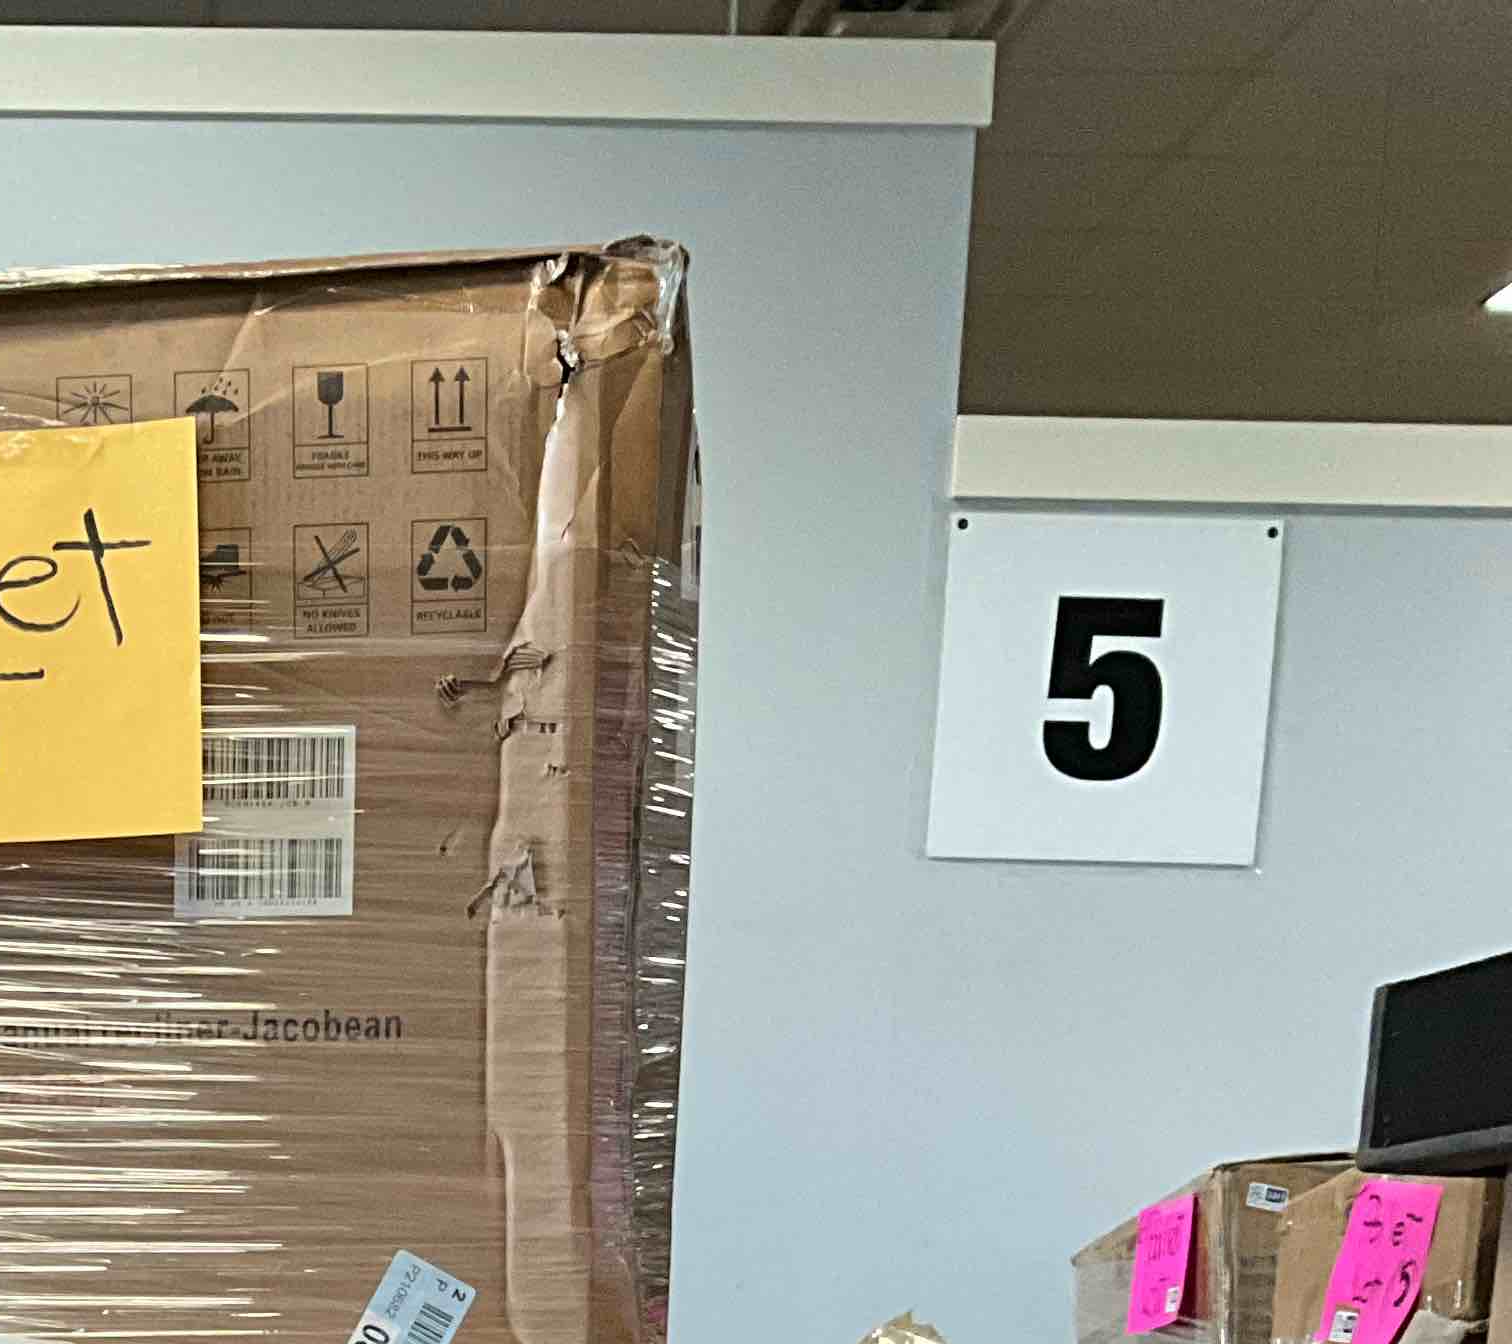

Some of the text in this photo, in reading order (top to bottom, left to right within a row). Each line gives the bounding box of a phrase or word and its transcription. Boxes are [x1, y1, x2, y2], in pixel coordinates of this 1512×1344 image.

[417, 449, 483, 462] THIS WAY UP
[1042, 596, 1165, 781] 5
